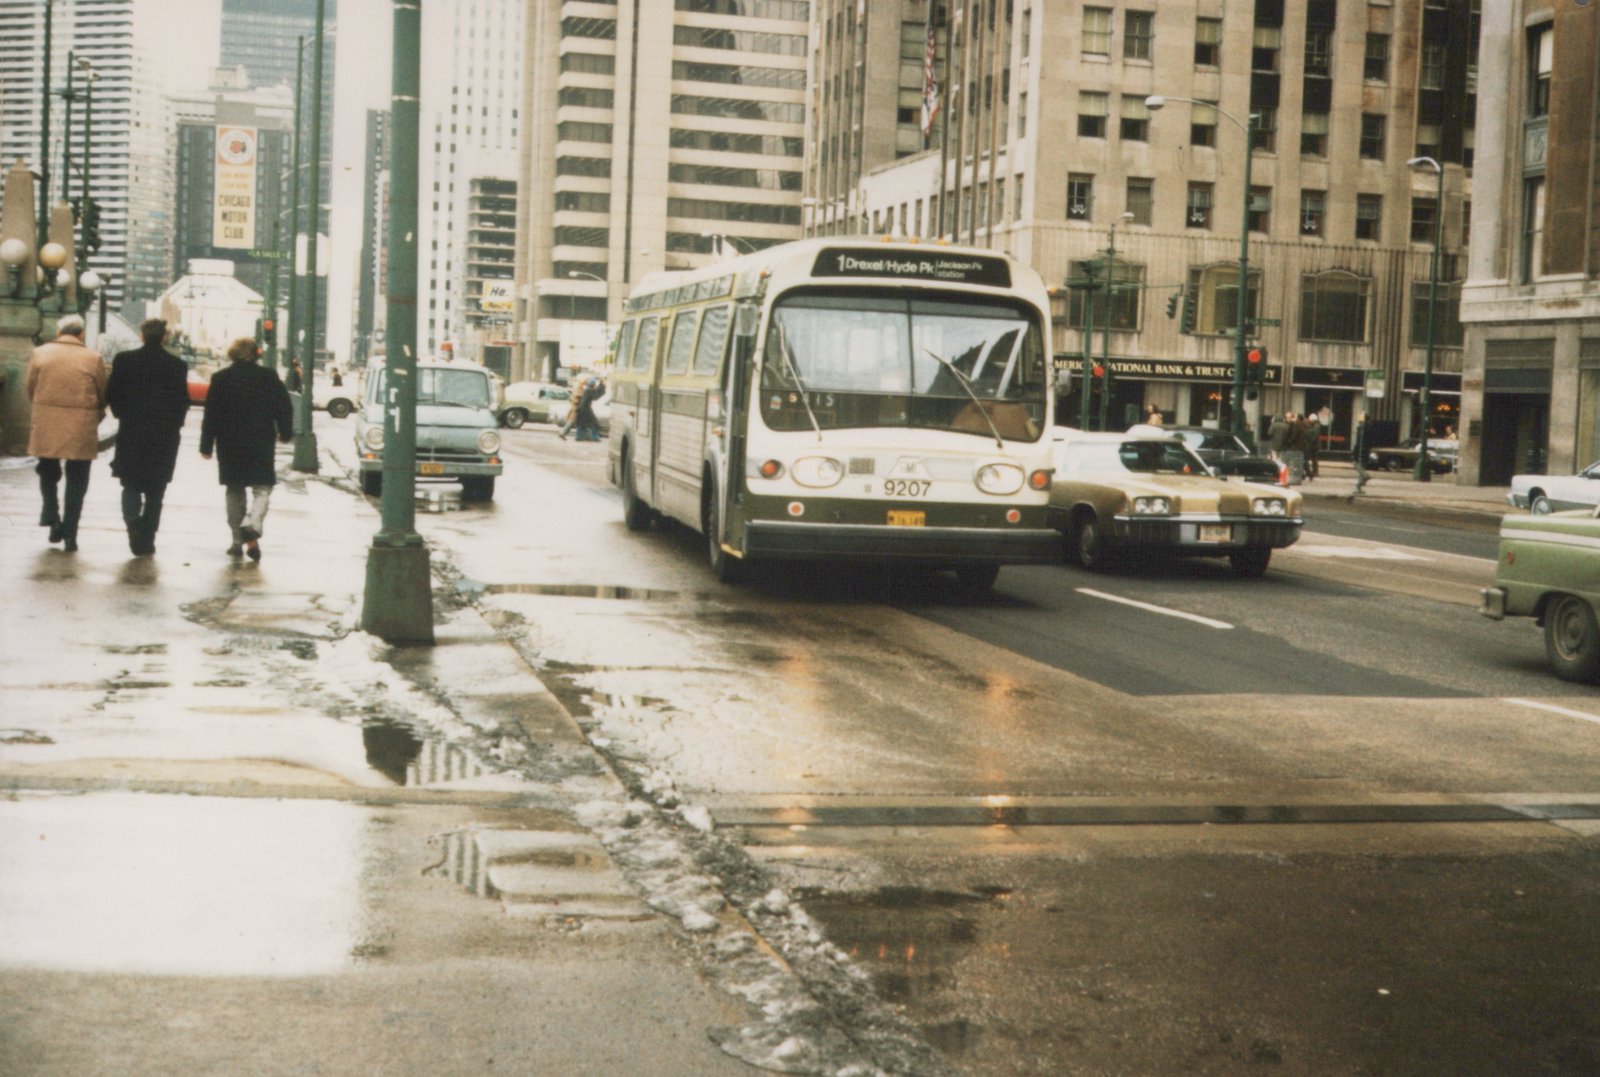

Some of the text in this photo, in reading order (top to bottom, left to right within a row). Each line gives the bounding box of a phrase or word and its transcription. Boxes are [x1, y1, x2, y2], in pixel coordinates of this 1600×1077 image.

[219, 194, 251, 208] CHICAGO
[222, 210, 248, 223] MOTOR
[224, 227, 244, 239] CLUB
[837, 254, 845, 272] 1
[920, 261, 935, 274] Pk
[1107, 361, 1153, 373] ATIONAL
[1155, 364, 1183, 375] BANK
[1185, 366, 1194, 376] &
[1195, 366, 1226, 377] TRUST
[884, 480, 932, 497] 9207
